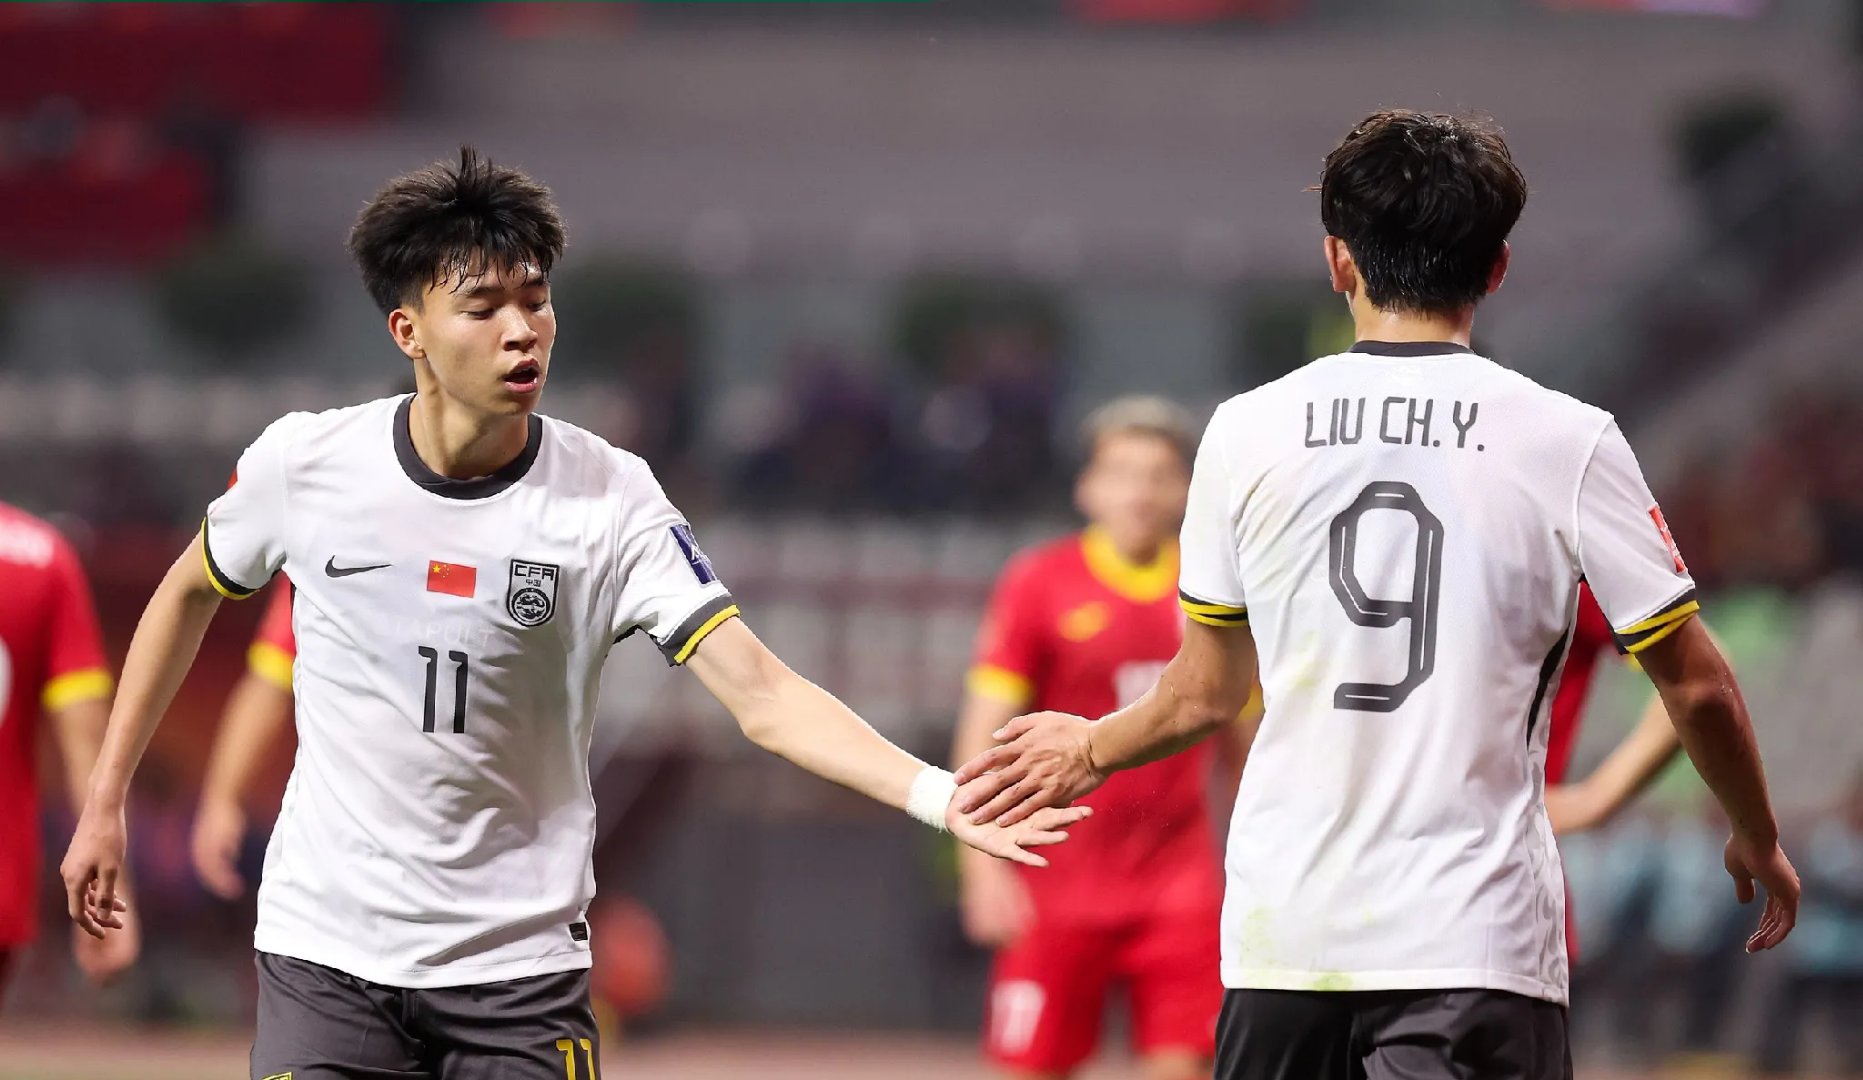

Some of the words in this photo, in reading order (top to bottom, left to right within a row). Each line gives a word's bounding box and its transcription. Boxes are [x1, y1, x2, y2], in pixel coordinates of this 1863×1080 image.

[1304, 397, 1366, 448] LIU
[514, 564, 555, 581] CFA
[1329, 480, 1444, 713] 9
[417, 645, 469, 734] 11
[555, 1038, 596, 1080] 11
